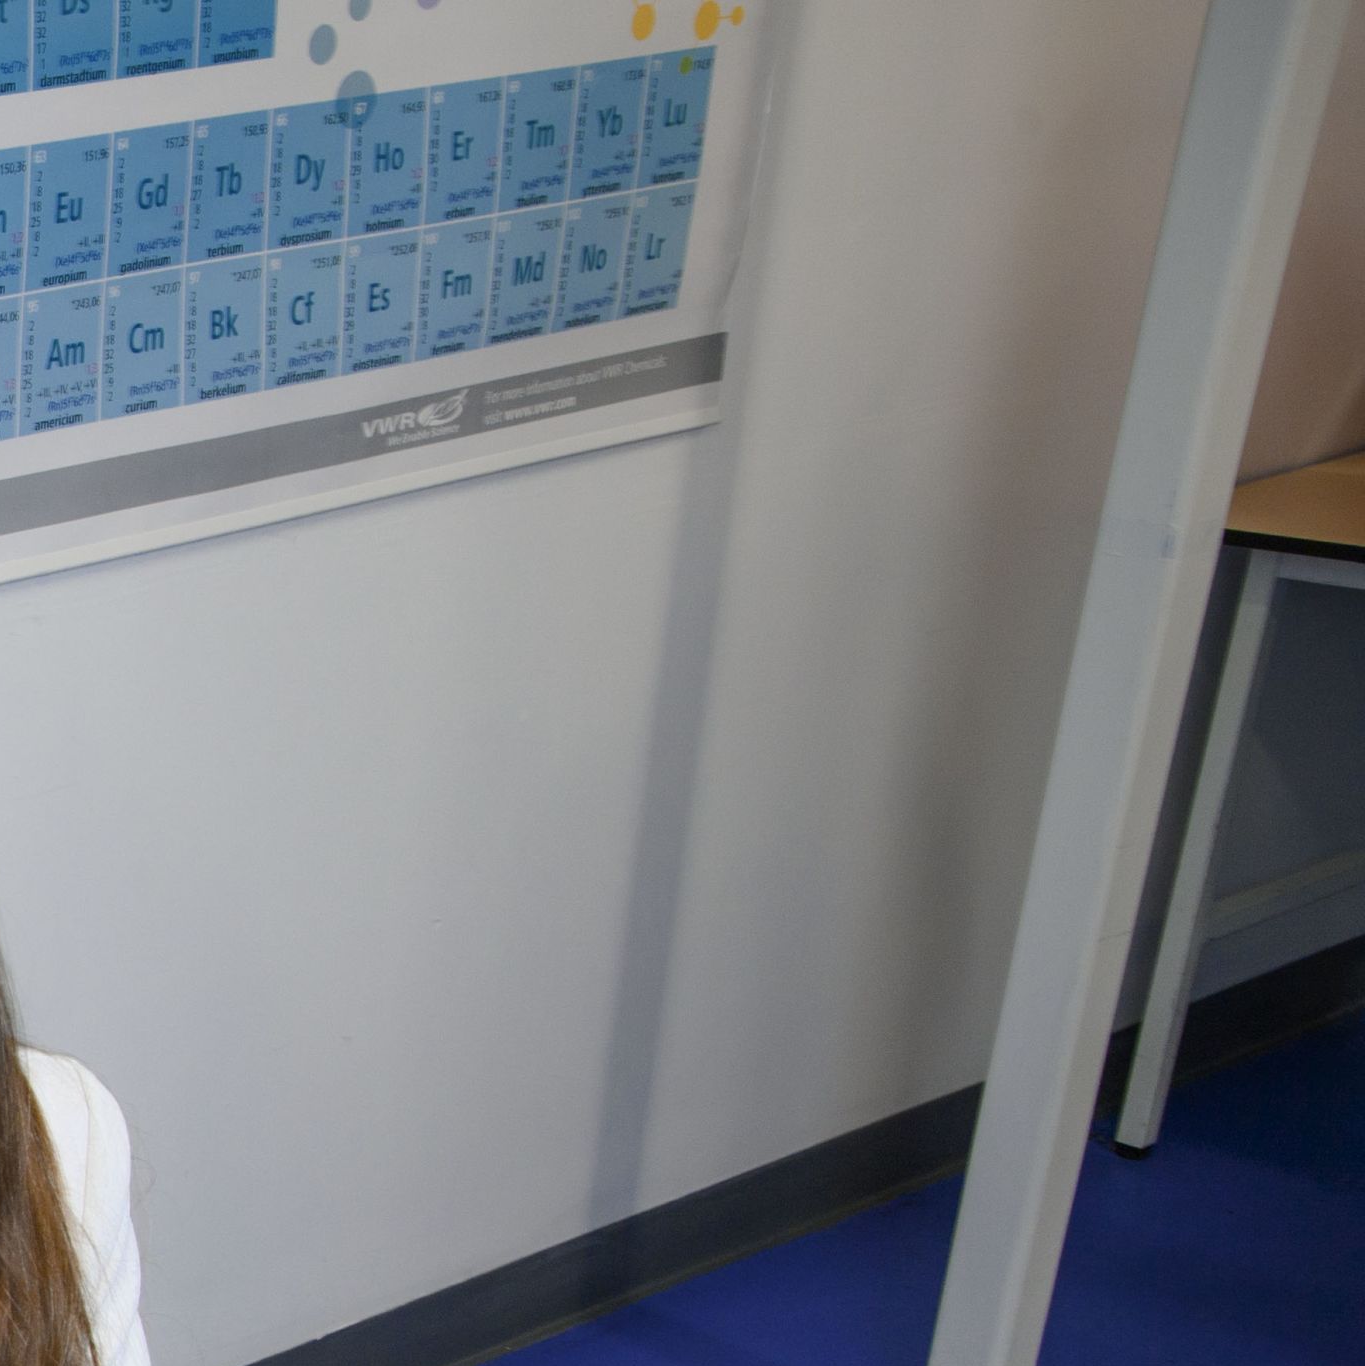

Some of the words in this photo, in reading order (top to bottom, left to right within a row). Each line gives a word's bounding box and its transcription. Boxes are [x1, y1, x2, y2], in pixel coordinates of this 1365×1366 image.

[40, 68, 107, 88] darmstadtium
[597, 105, 623, 138] Yb
[663, 98, 687, 127] Lu
[452, 131, 474, 161] Er
[525, 119, 555, 149] Tm
[295, 154, 326, 191] Dy
[374, 142, 405, 173] Ho
[137, 173, 169, 210] Gd
[215, 163, 242, 197] Tb
[55, 192, 83, 223] Eu
[207, 243, 244, 257] terbium
[280, 229, 332, 247] dysprosium
[643, 232, 666, 260] Lr
[120, 255, 171, 274] gadolinium
[512, 251, 546, 286] Md
[580, 243, 608, 273] No
[43, 269, 87, 287] europium
[442, 269, 473, 300] Fm
[290, 291, 316, 325] Cf
[368, 282, 391, 312] Es
[129, 323, 165, 353] Cm
[210, 306, 239, 340] Bk
[45, 339, 85, 370] Am
[200, 382, 247, 400] berkelium
[276, 368, 327, 386] californium
[34, 412, 83, 431] americium
[125, 399, 158, 414] curium
[361, 410, 416, 438] VWR
